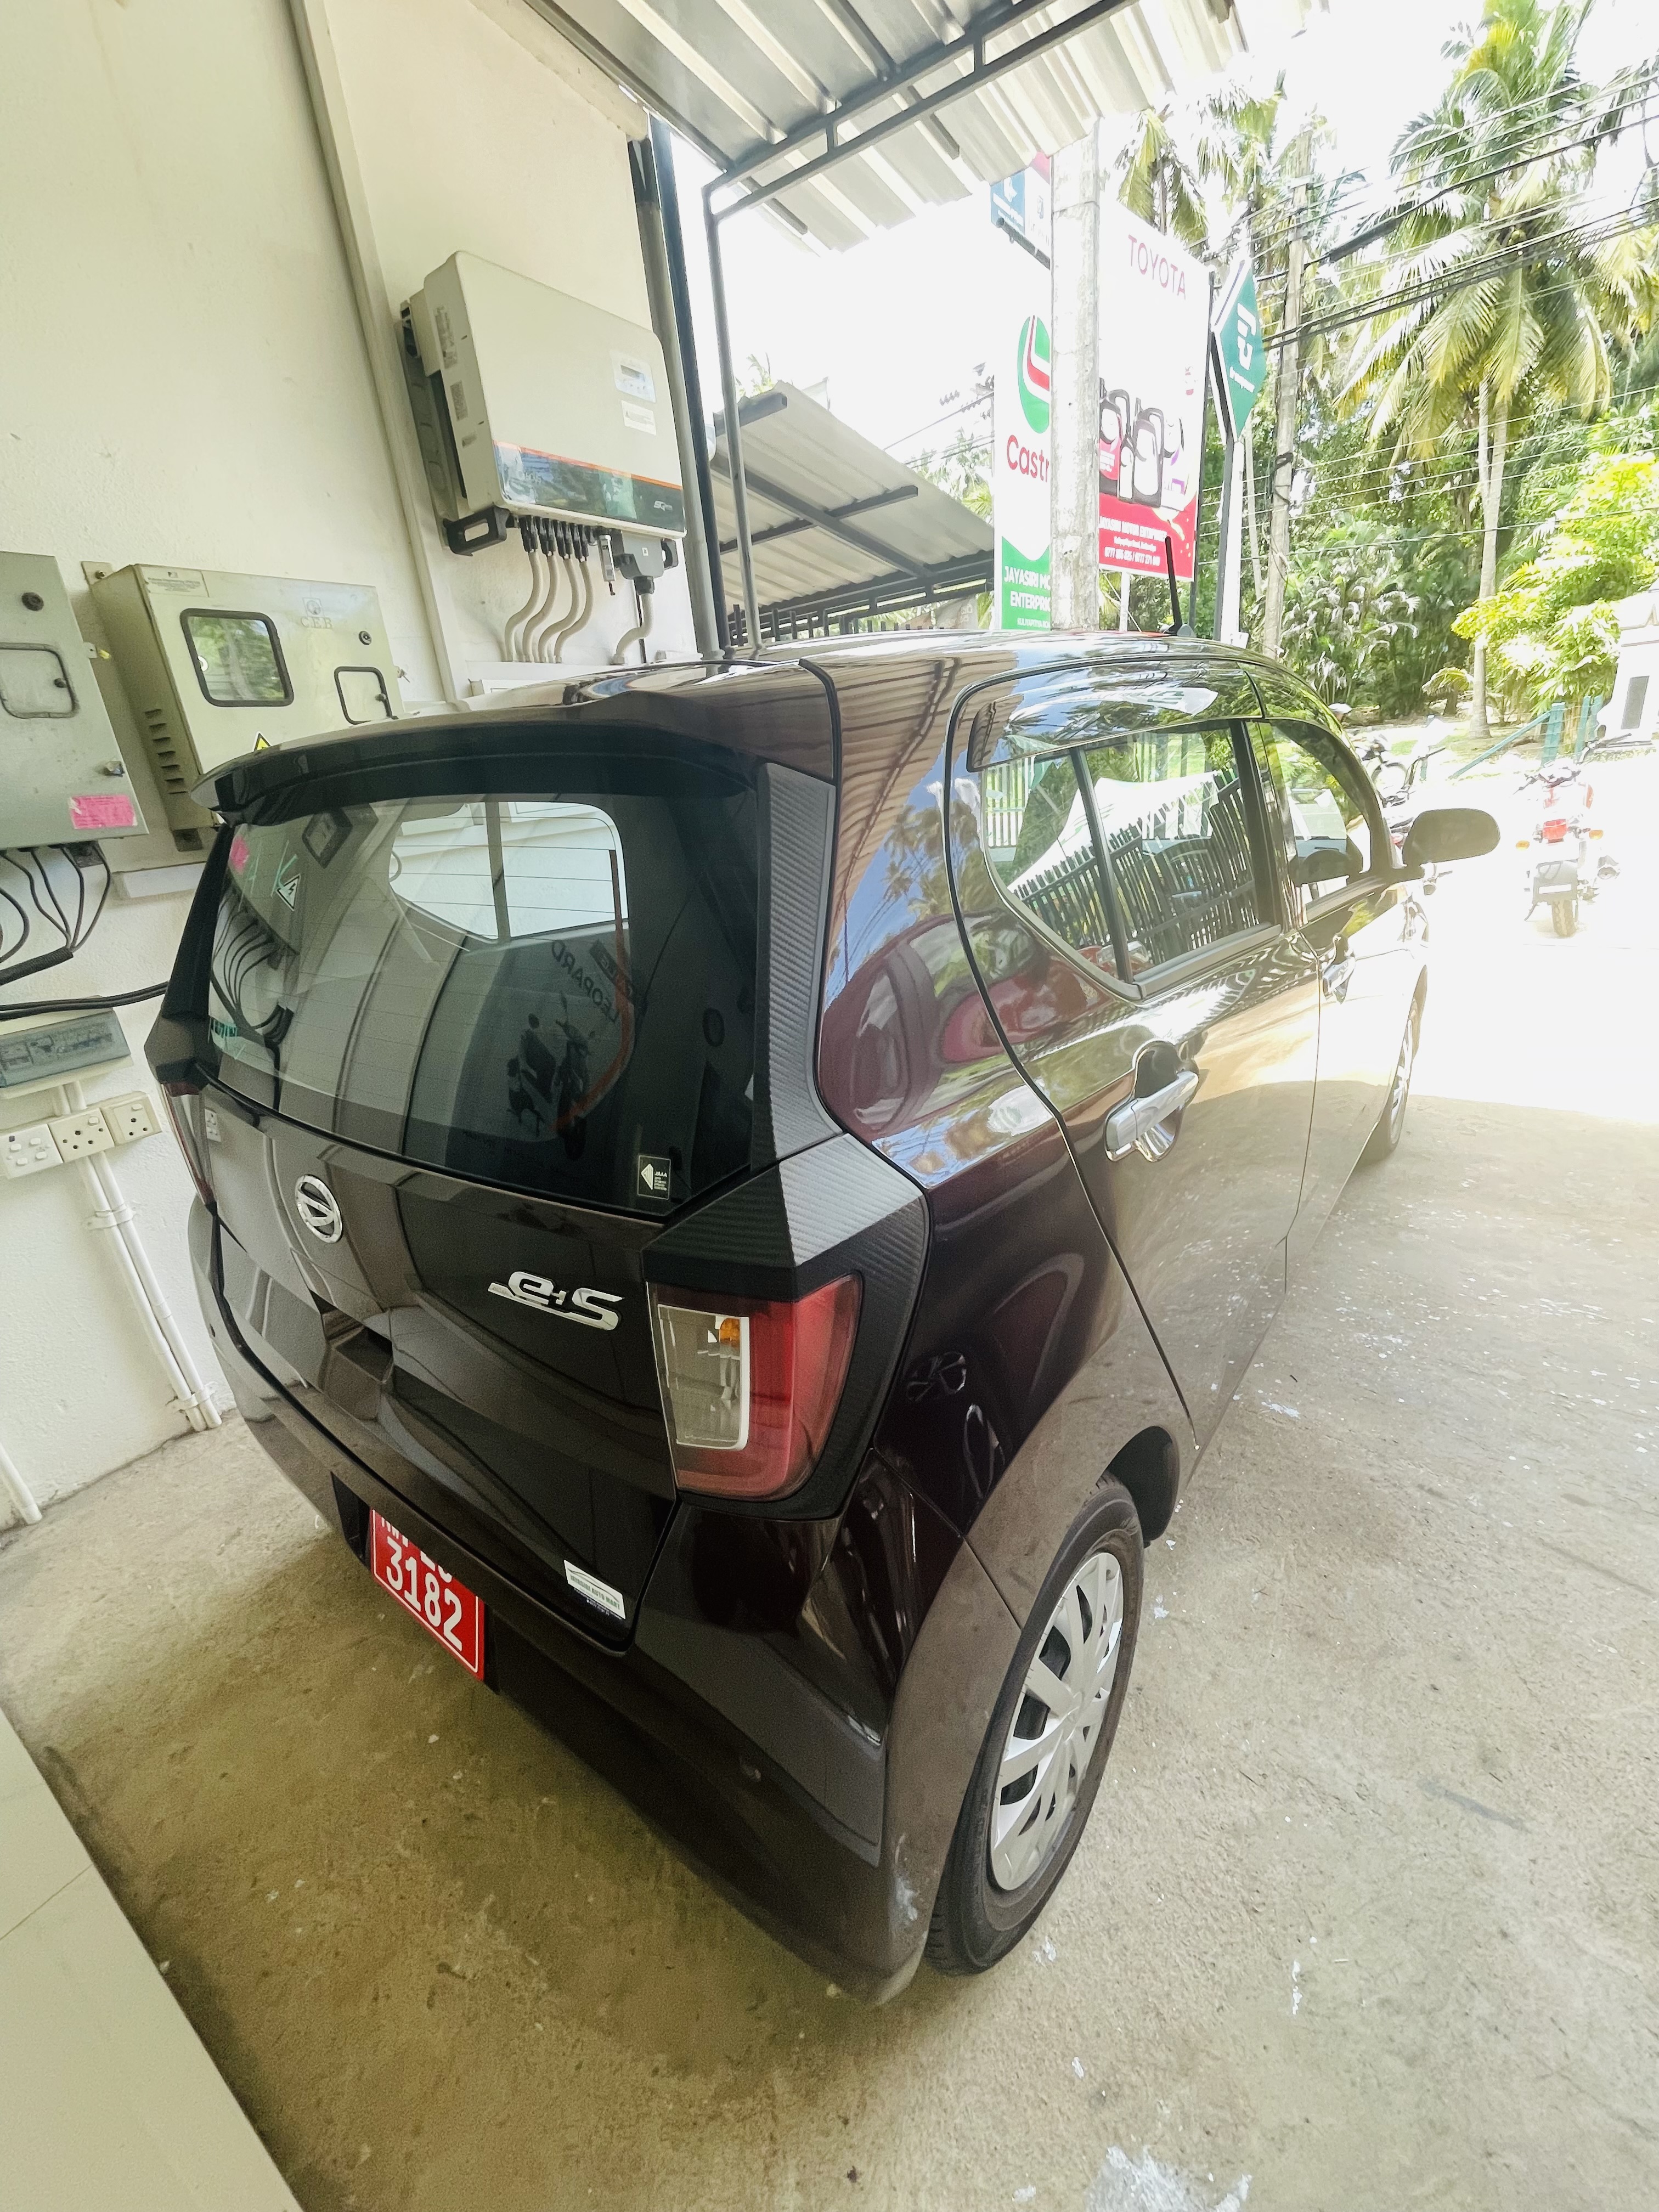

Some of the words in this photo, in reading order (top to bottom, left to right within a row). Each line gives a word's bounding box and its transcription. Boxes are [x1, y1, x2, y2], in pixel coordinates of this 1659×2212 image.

[1128, 234, 1186, 301] TOYOTA
[1007, 435, 1049, 483] Castr
[1004, 566, 1039, 589] JAYASIRI
[386, 1536, 462, 1652] 3182
